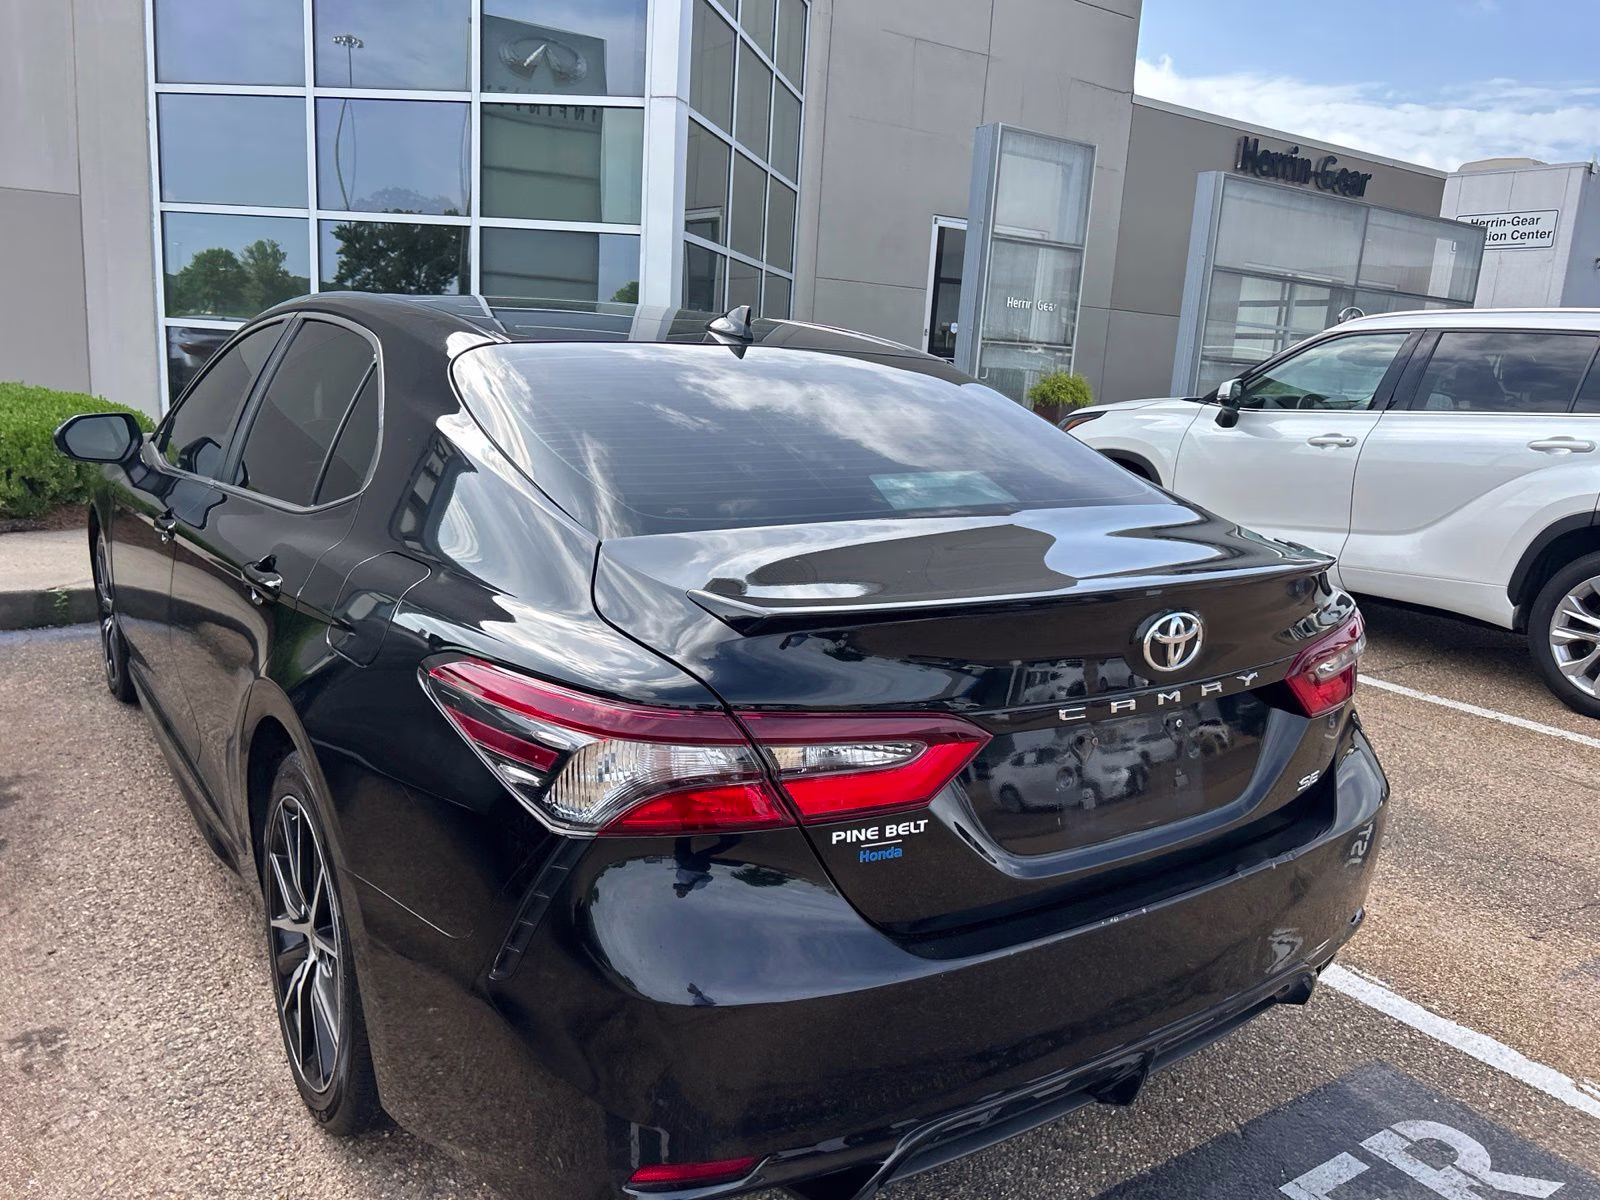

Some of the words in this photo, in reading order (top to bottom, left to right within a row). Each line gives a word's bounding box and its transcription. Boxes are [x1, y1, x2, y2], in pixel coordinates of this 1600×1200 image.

[1235, 136, 1373, 198] Herrin-Gear
[1485, 231, 1507, 242] ion
[1510, 229, 1553, 241] Center
[1037, 299, 1058, 312] Gear
[1058, 671, 1259, 722] CAMRY
[1297, 769, 1321, 792] SE
[831, 826, 879, 845] PINE
[885, 819, 929, 838] BELT
[859, 846, 903, 863] Honda
